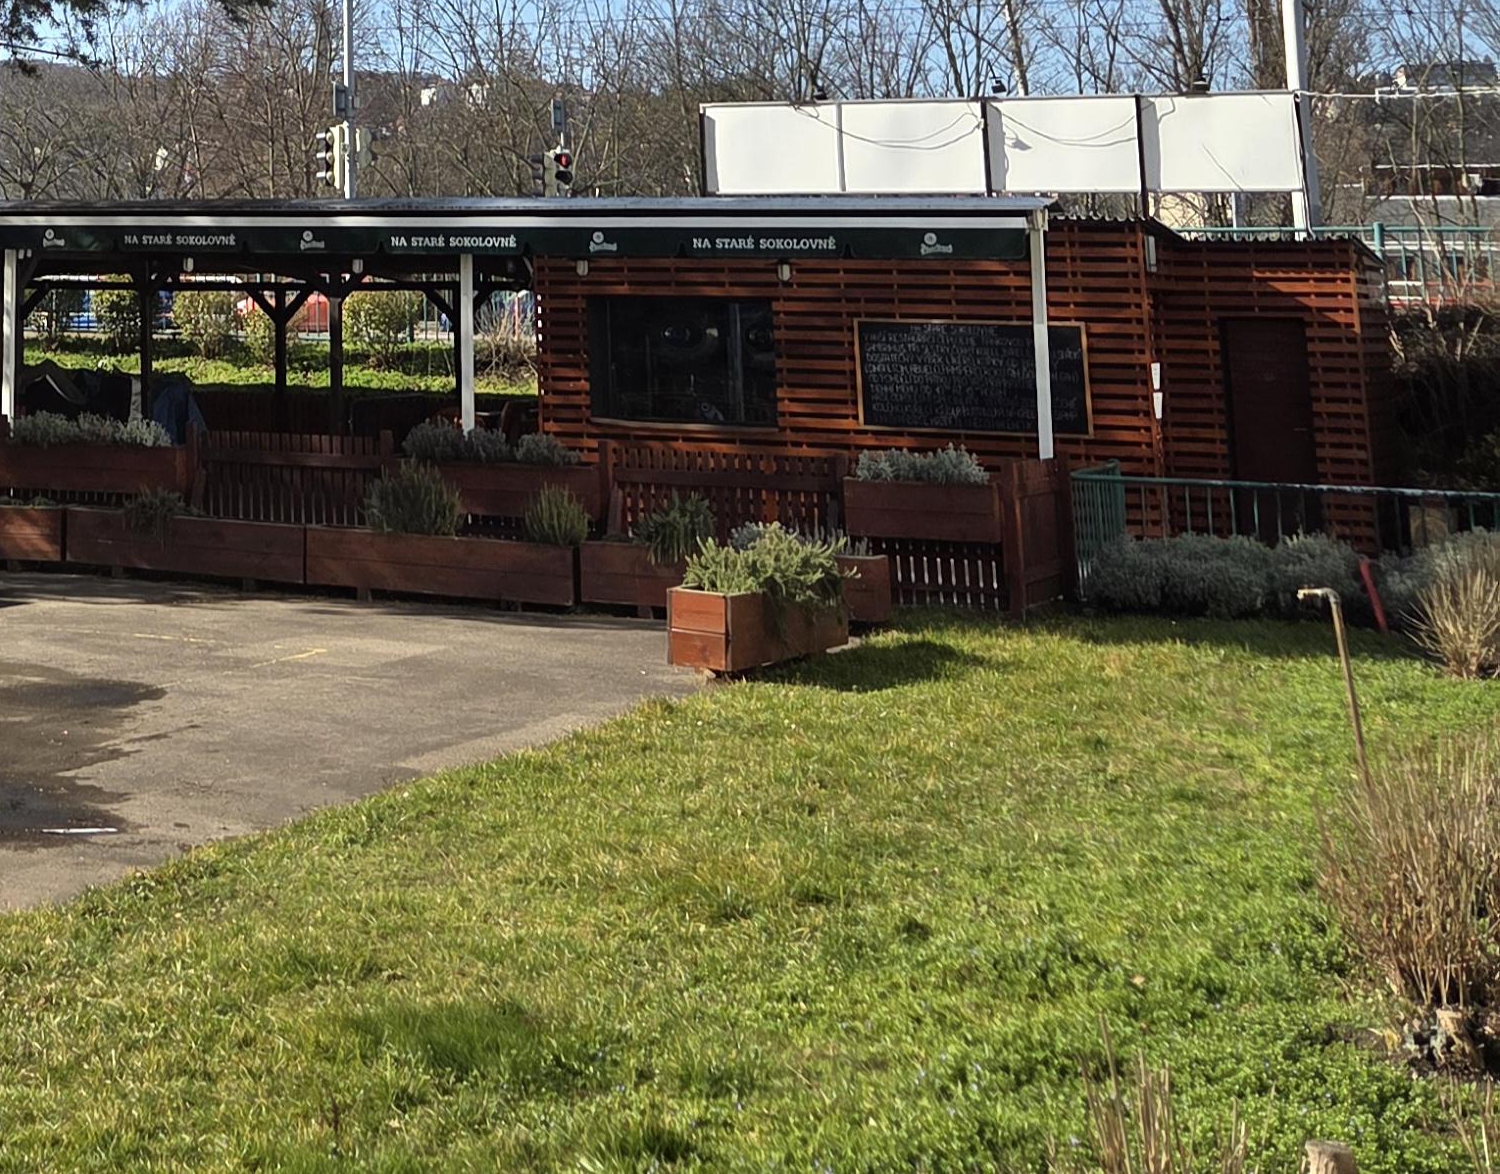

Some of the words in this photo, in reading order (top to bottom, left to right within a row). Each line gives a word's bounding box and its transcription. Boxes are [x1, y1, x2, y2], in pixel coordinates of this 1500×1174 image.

[125, 235, 139, 245] NA
[142, 233, 173, 245] STARÉ
[391, 236, 407, 247] NA
[411, 234, 445, 247] STARÉ
[692, 238, 711, 248] NA
[716, 235, 754, 249] STARÉ
